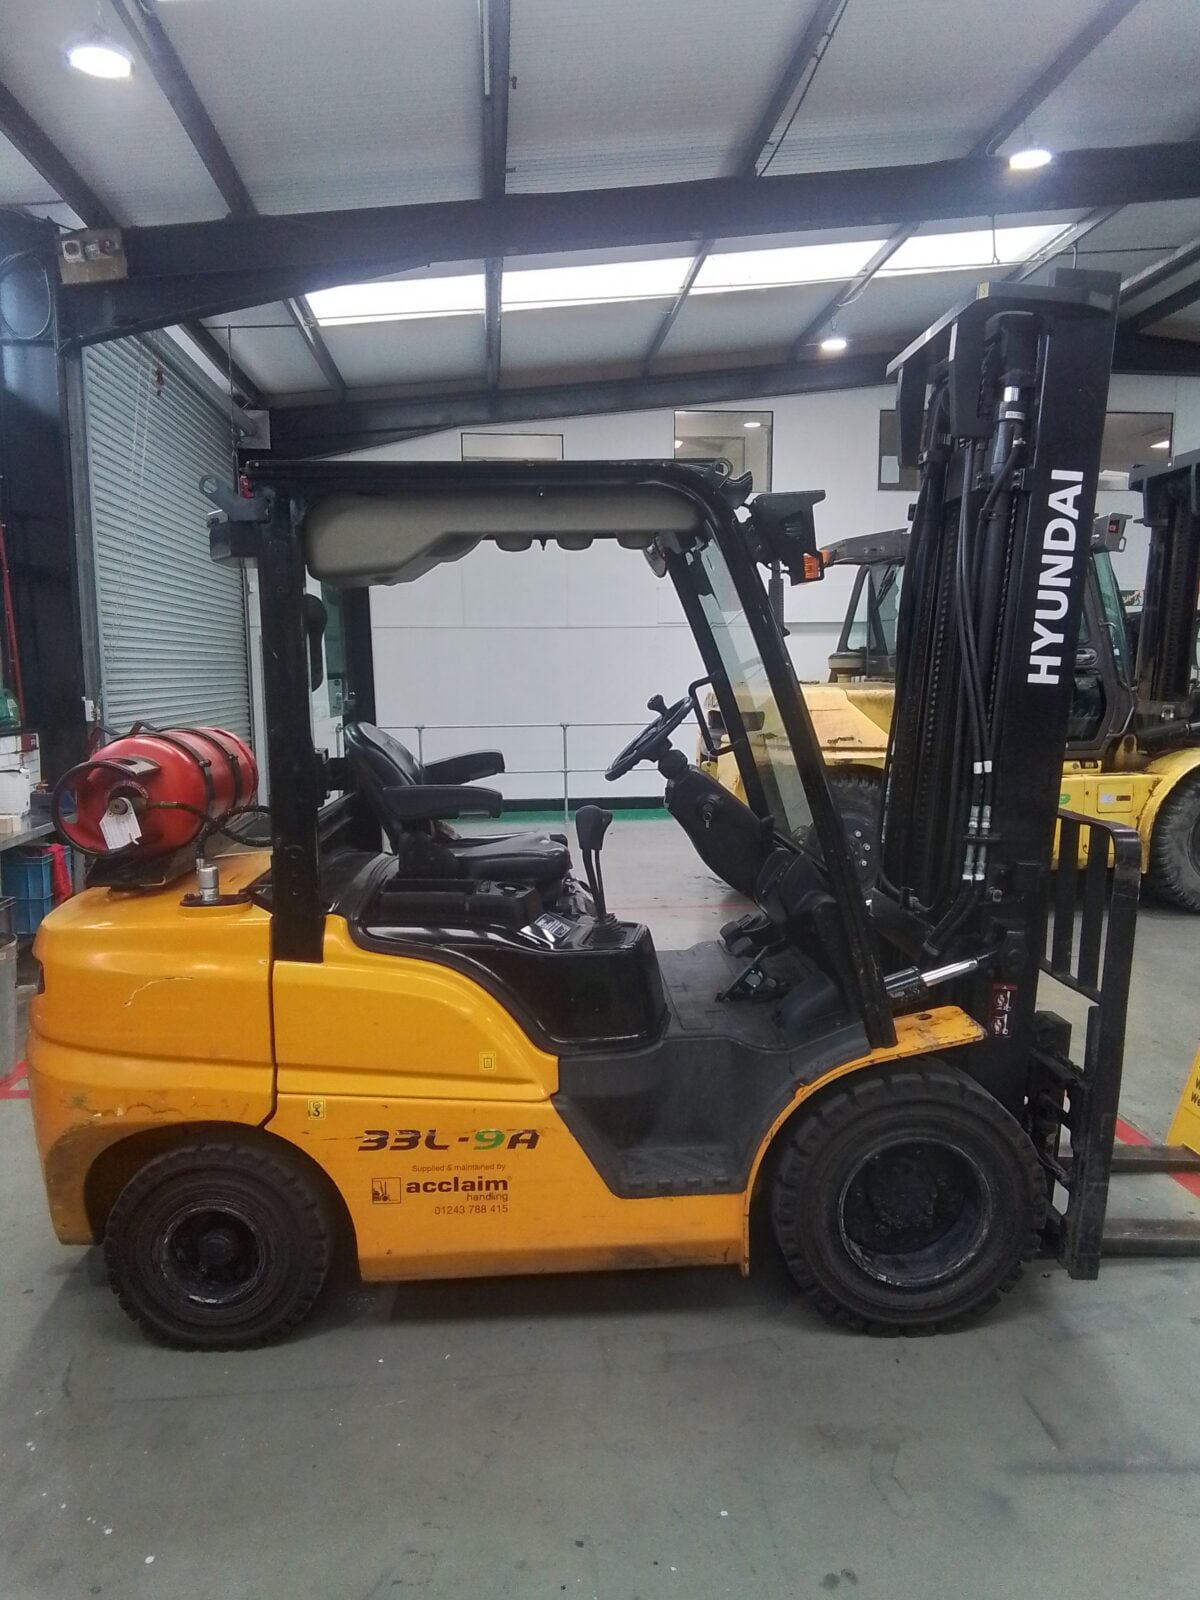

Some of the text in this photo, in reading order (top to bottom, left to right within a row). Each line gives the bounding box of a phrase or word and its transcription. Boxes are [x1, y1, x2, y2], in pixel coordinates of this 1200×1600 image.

[1027, 469, 1084, 685] HYUNDAI
[412, 1164, 445, 1173] Supplied
[454, 1163, 495, 1171] maintained
[496, 1163, 506, 1171] by
[406, 1176, 508, 1193] acclaim
[466, 1192, 508, 1202] handling
[434, 1204, 509, 1215] 01243 788 415
